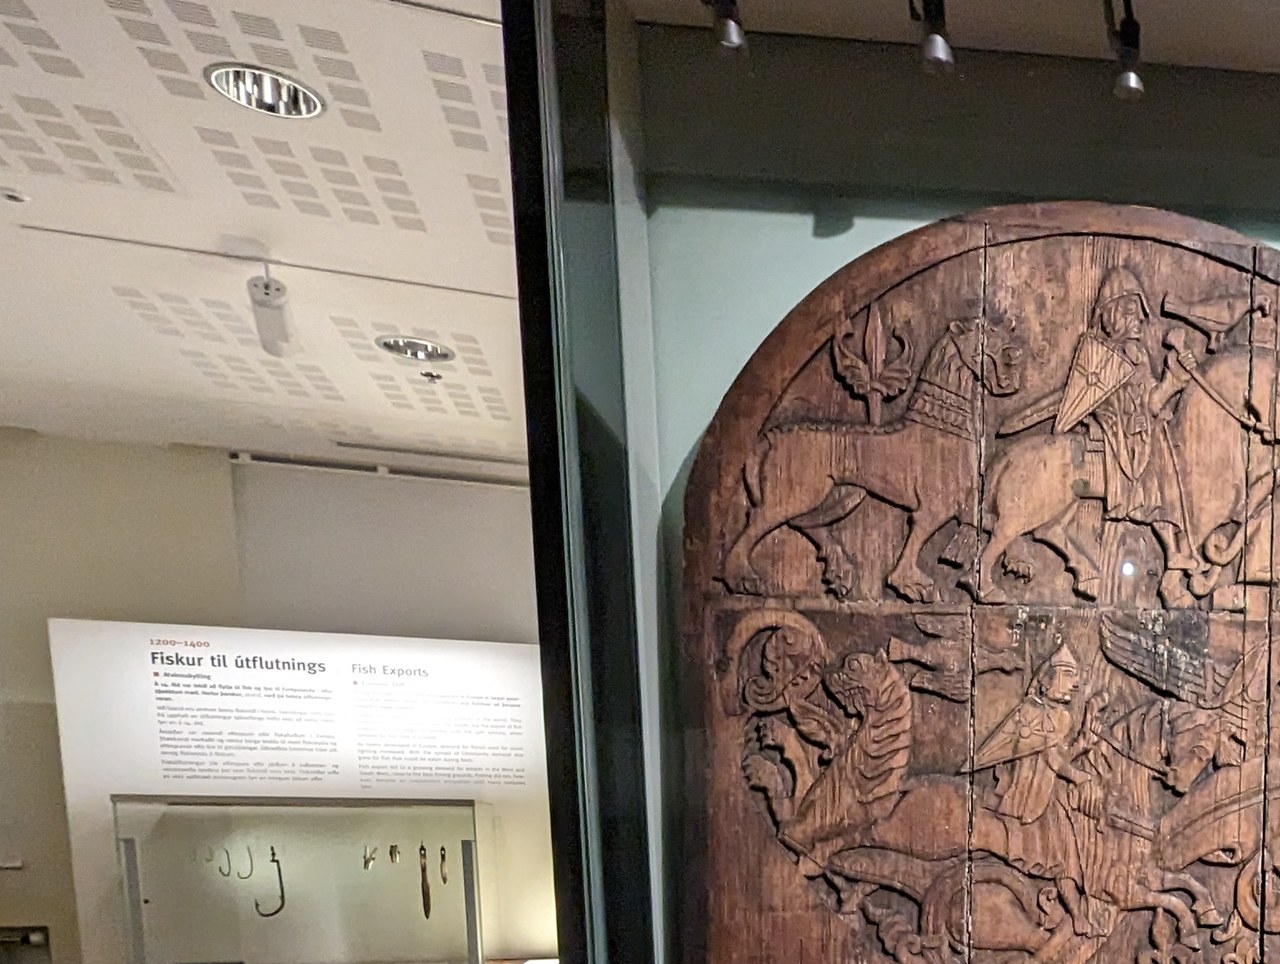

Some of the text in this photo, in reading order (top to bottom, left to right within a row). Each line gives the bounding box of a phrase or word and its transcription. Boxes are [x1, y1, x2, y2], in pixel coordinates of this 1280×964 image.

[151, 652, 326, 674] Fiskur til útflutnings
[352, 664, 429, 677] Fish Exports
